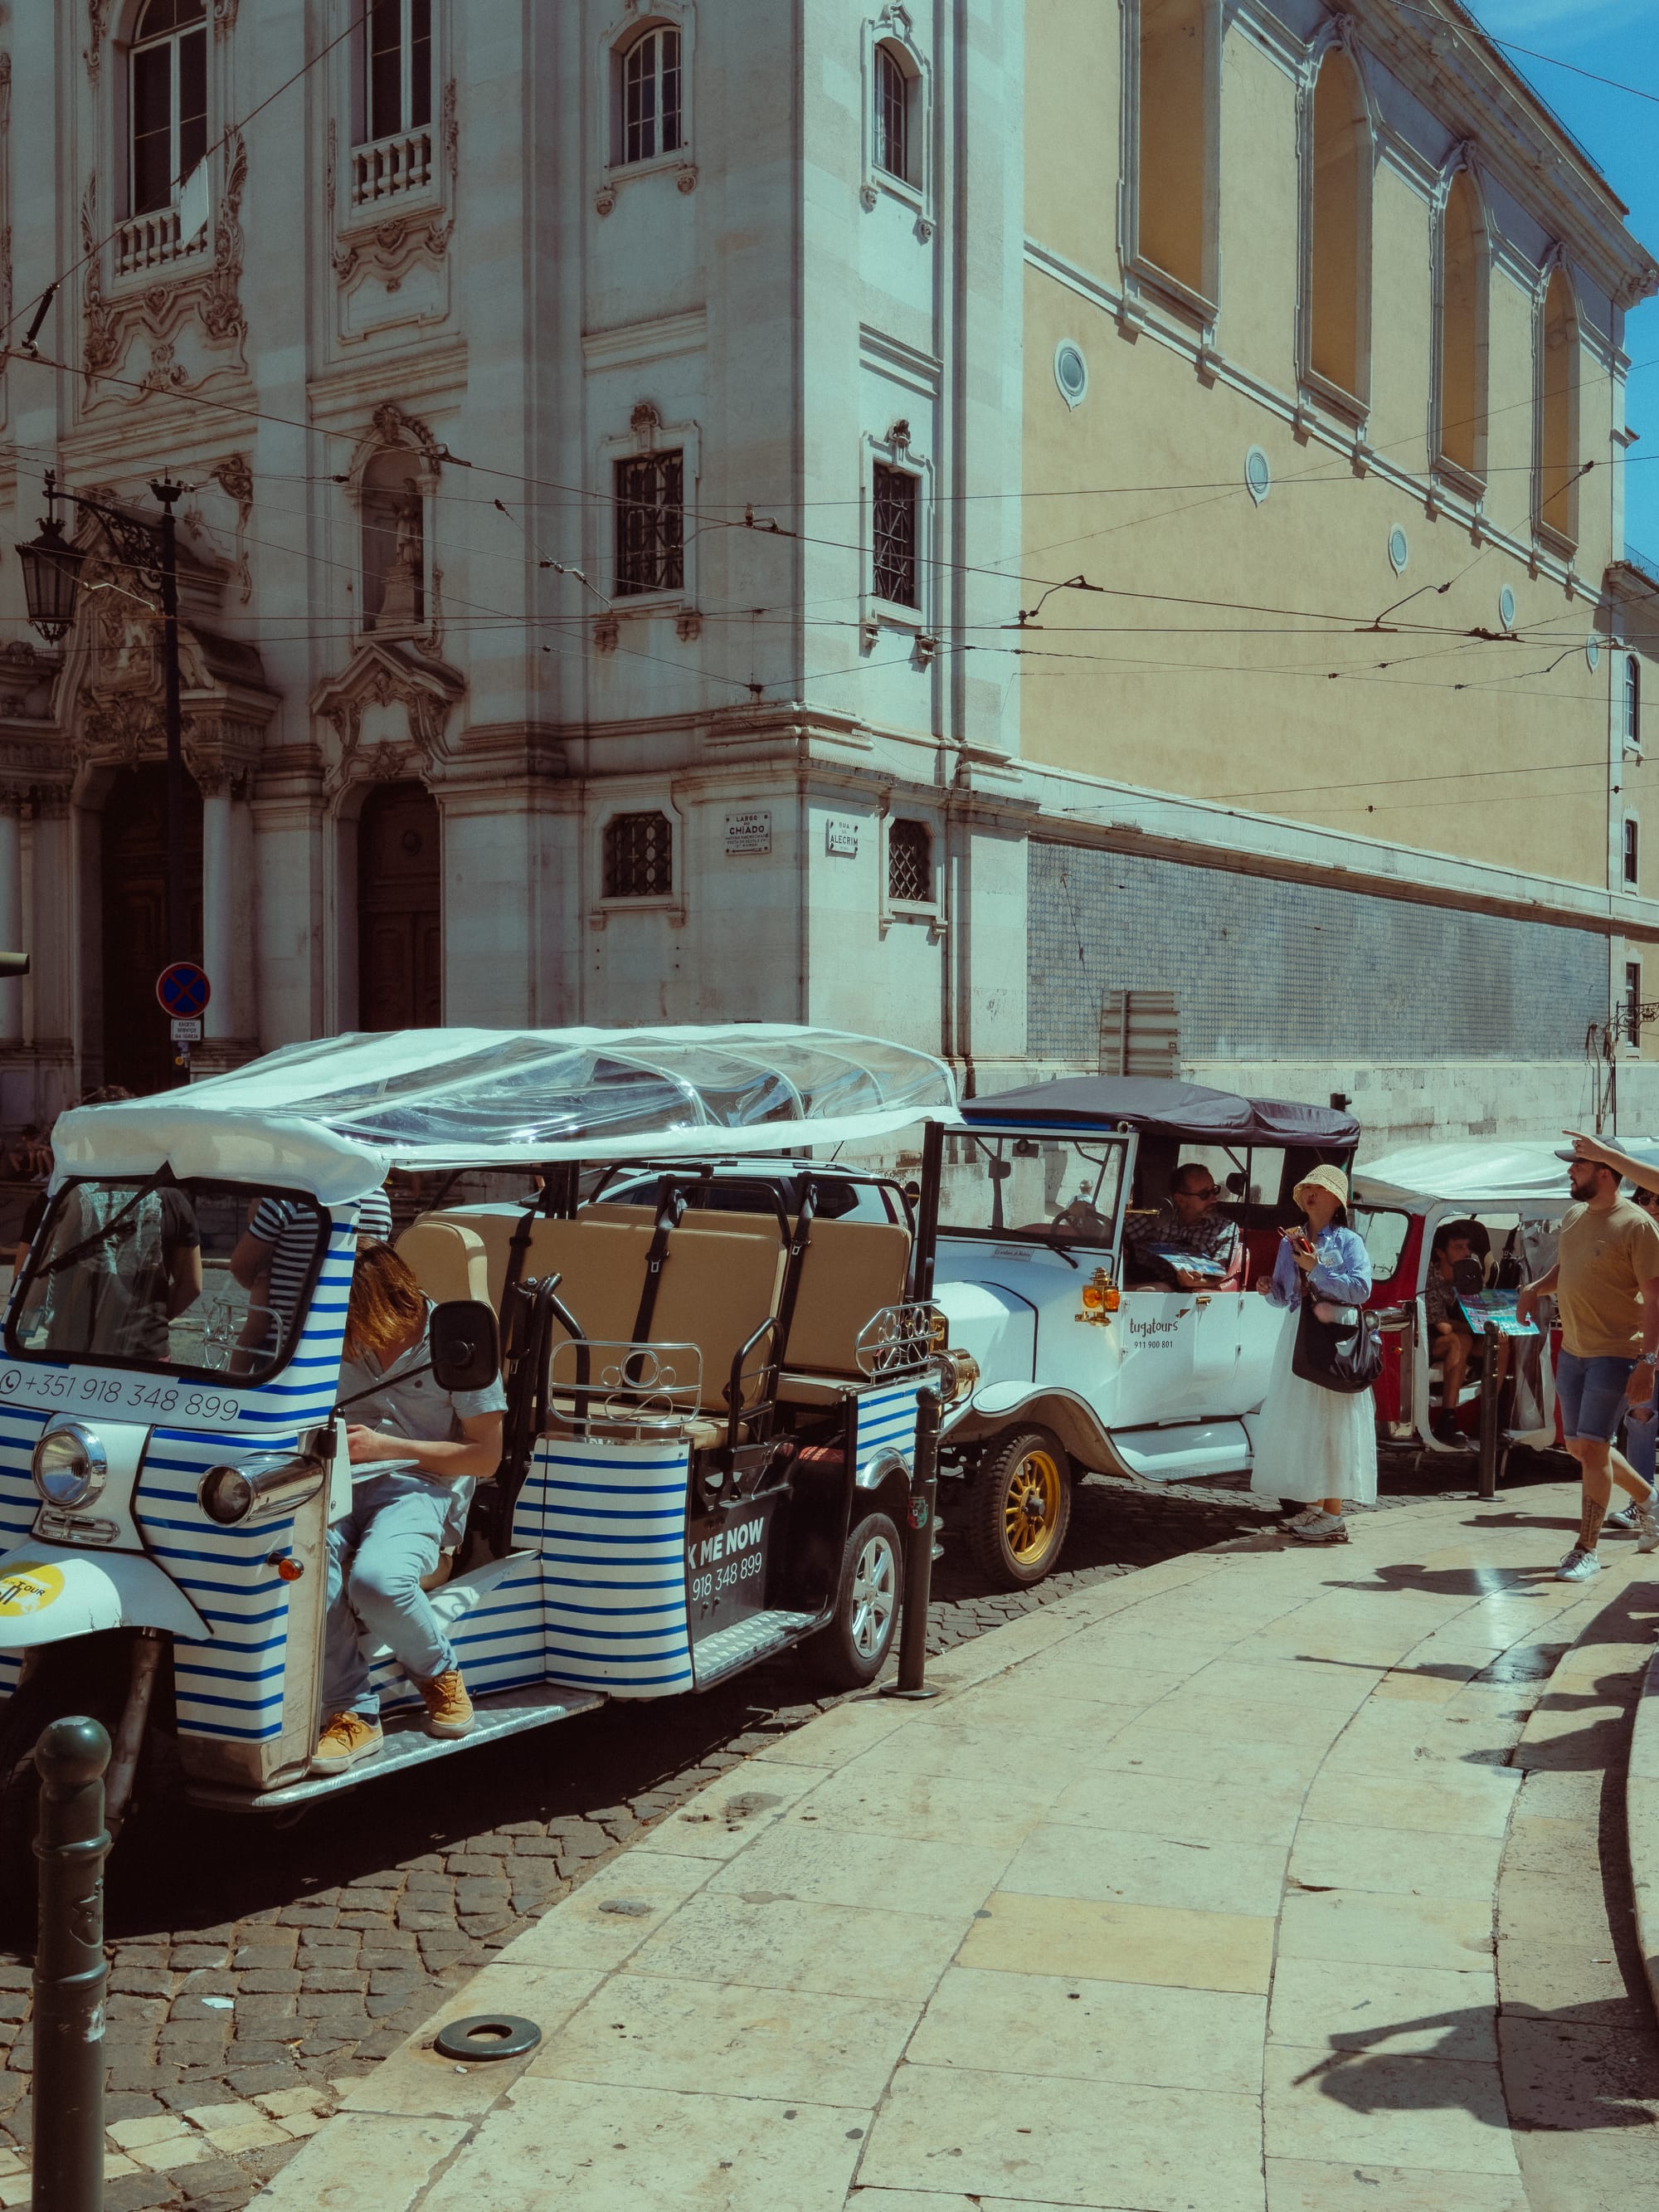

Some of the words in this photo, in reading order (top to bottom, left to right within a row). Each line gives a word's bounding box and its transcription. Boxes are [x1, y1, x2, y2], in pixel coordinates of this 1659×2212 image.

[729, 825, 765, 835] CHIADO
[830, 834, 859, 846] ALECRIM
[1129, 1318, 1179, 1337] tugatours
[1148, 1340, 1160, 1348] 900
[1161, 1340, 1173, 1348] 801
[26, 1374, 76, 1397] +351
[80, 1378, 122, 1403] 918
[127, 1384, 179, 1411] 348
[184, 1393, 239, 1421] 899
[700, 1532, 724, 1566] ME
[726, 1517, 764, 1556] NOW
[693, 1573, 713, 1601] 918
[715, 1562, 737, 1591] 348
[740, 1552, 762, 1580] 899
[17, 1581, 46, 1596] TOUR
